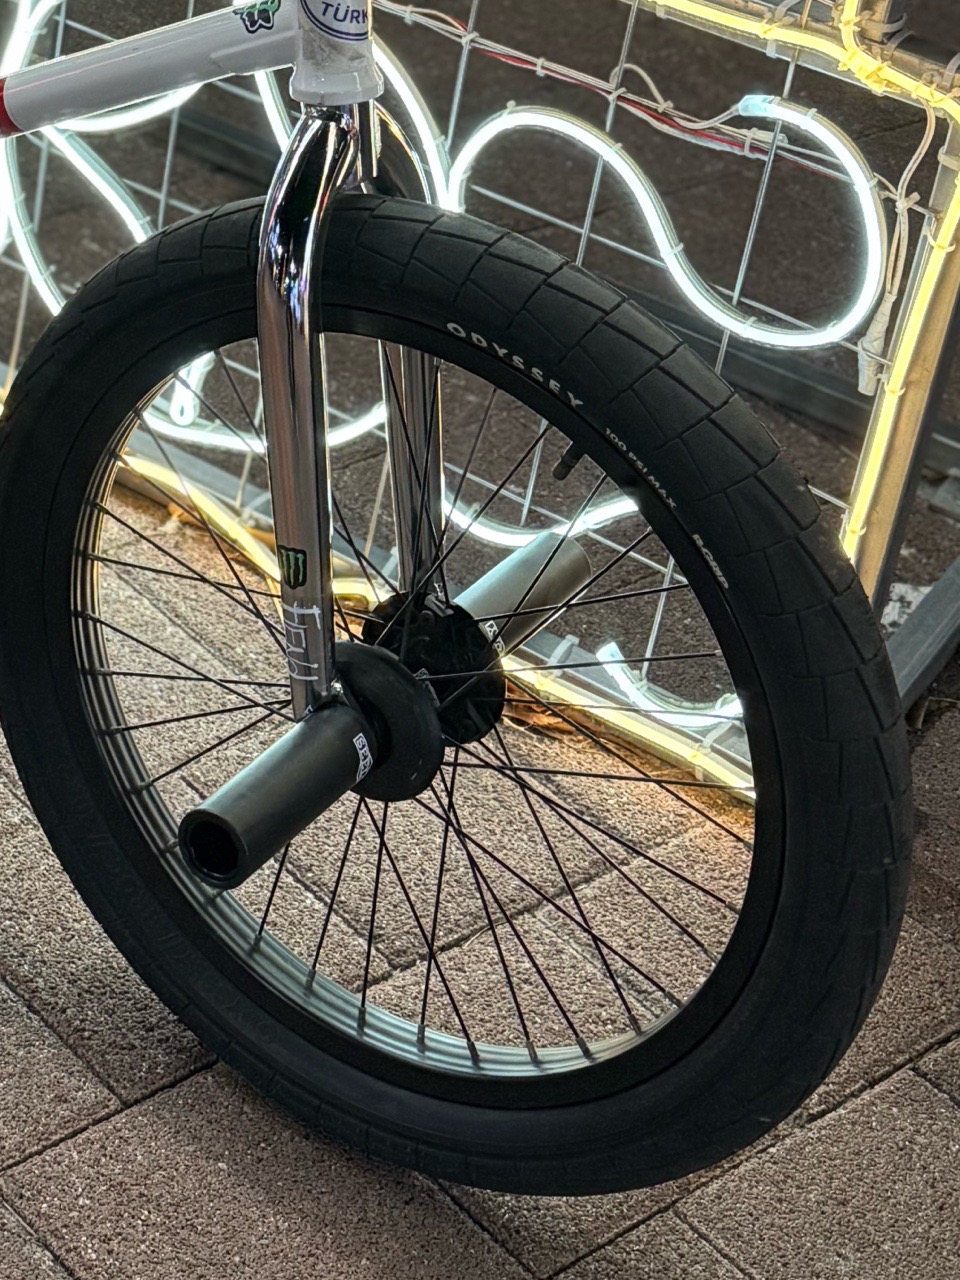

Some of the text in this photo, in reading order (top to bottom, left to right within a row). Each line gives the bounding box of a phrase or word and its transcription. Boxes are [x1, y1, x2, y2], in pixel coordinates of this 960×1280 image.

[446, 321, 583, 407] ODYSSEY
[605, 427, 677, 508] 100 PSI MAX
